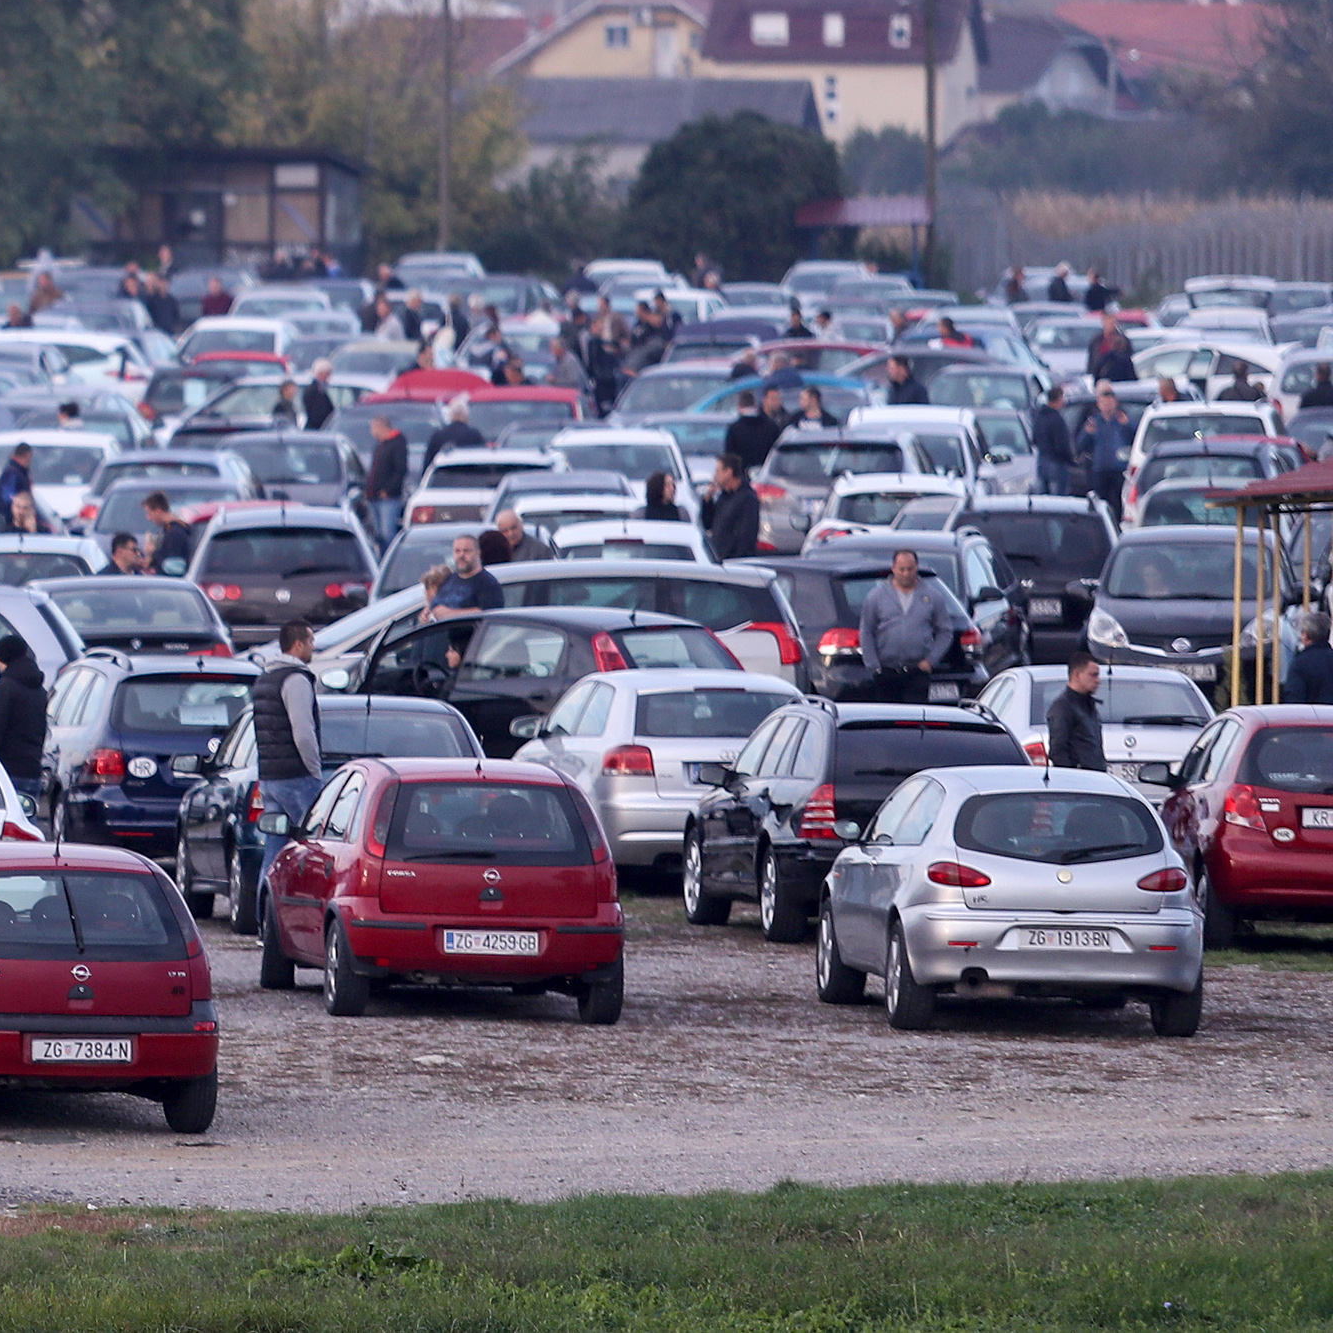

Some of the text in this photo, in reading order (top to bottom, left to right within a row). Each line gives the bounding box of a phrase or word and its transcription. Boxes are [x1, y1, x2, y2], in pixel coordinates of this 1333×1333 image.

[454, 932, 473, 949] ZG
[1027, 930, 1046, 946] ZG
[43, 1041, 63, 1058] ZG
